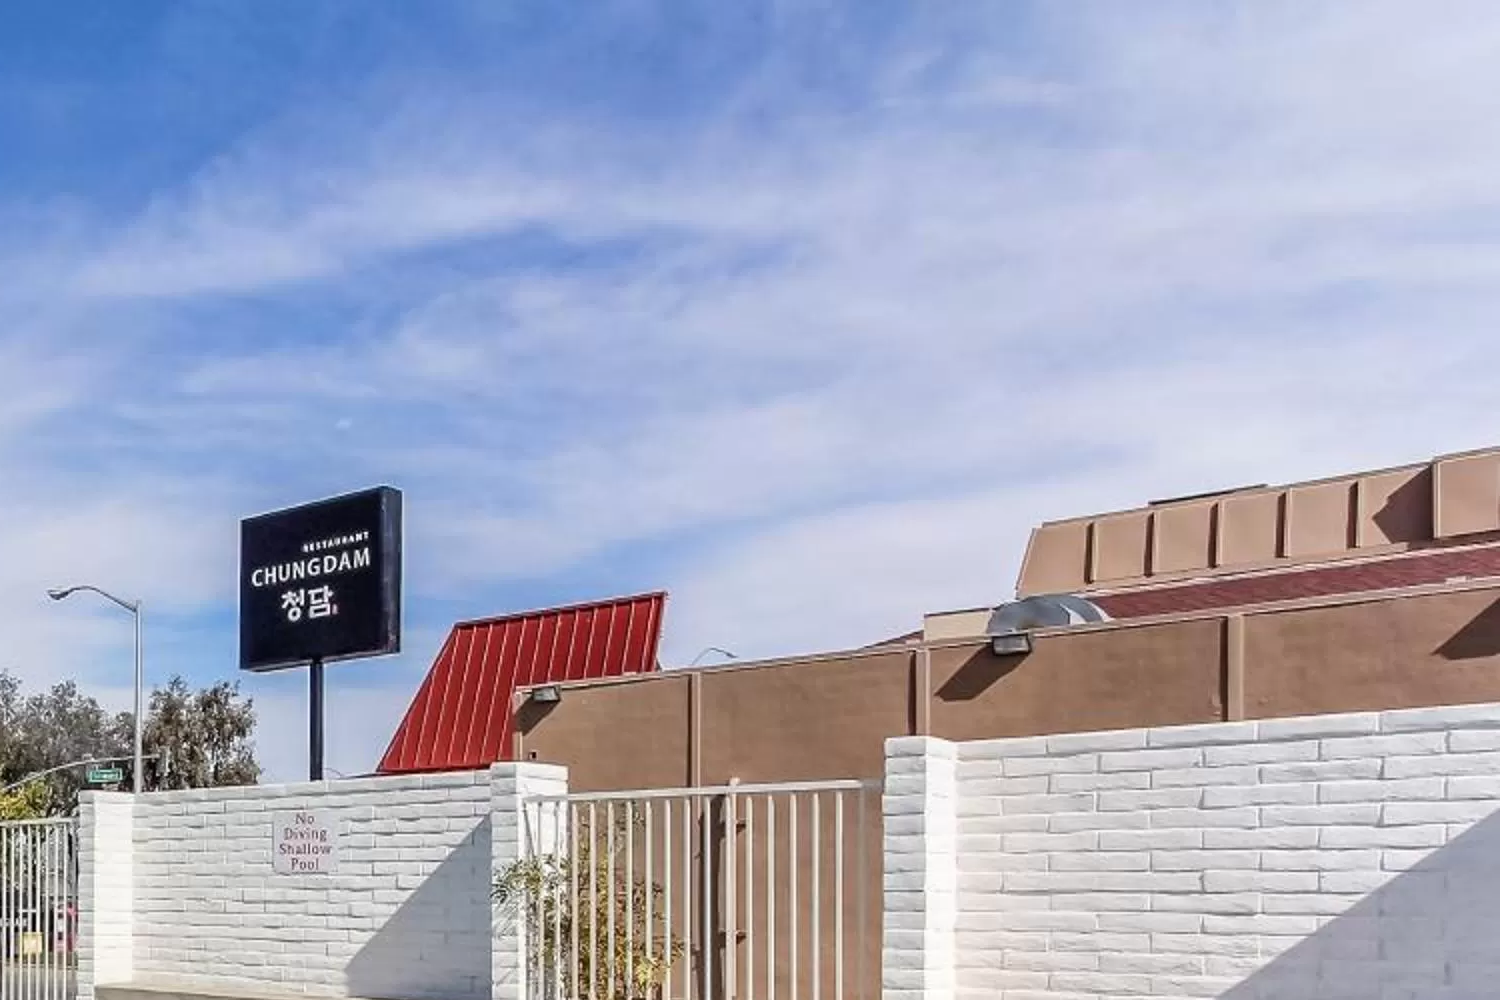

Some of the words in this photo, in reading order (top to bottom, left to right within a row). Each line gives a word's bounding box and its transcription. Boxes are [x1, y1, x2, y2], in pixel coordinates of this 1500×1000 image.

[303, 531, 370, 553] RESTAURANT
[251, 547, 371, 588] CHUNGDAM
[281, 585, 334, 622] 청담
[295, 812, 315, 825] No
[283, 827, 328, 842] Diving
[279, 843, 333, 855] Shallow
[291, 857, 319, 871] Pool
